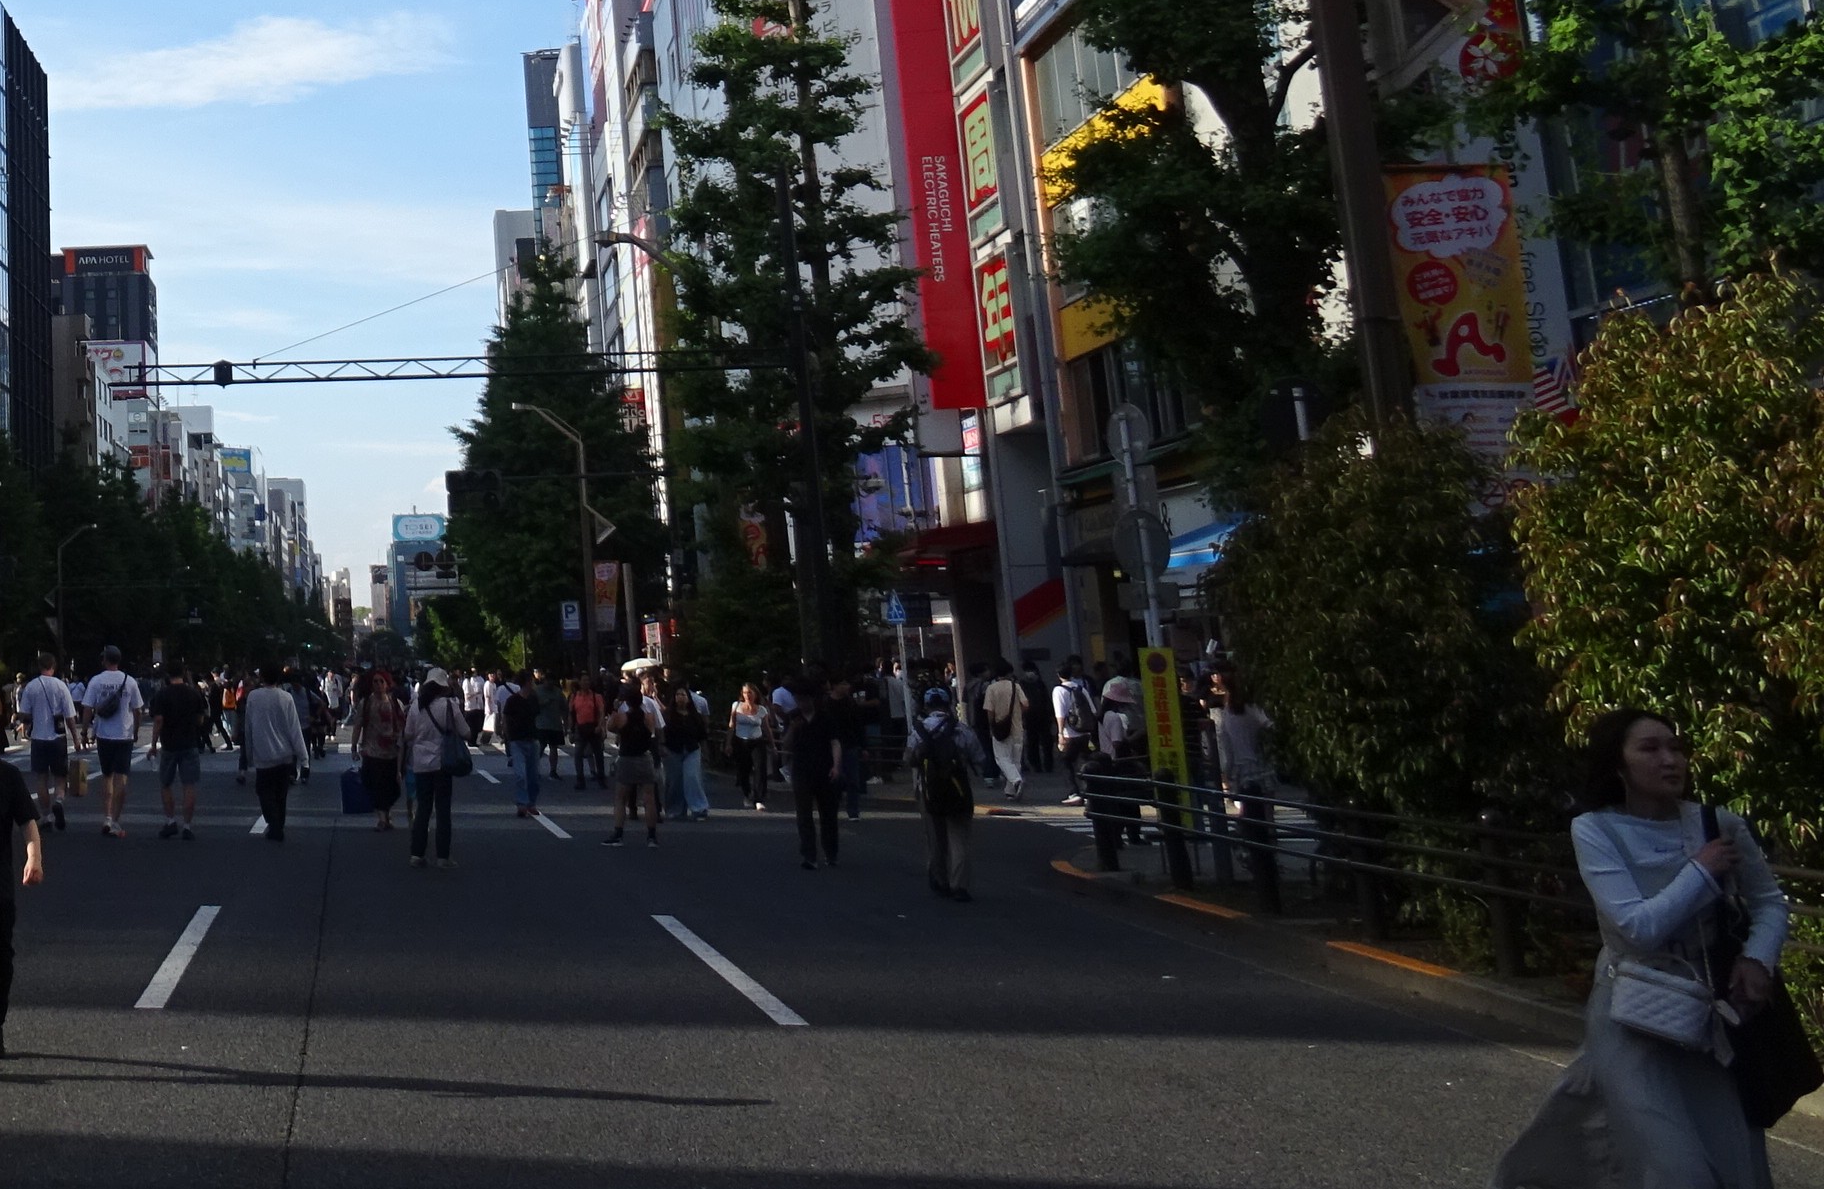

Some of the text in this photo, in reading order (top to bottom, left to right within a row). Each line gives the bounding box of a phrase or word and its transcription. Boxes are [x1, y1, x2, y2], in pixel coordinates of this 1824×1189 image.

[934, 154, 952, 232] SAKAGUCHI
[1401, 187, 1484, 207] みんなで協力
[921, 155, 945, 282] ELECTRIC HEATERS
[1405, 205, 1489, 229] 安全・安心
[1410, 224, 1492, 245] 元気なアキバ
[78, 255, 130, 265] APA HOTEL
[1527, 301, 1547, 359] Shop
[564, 604, 577, 619] P
